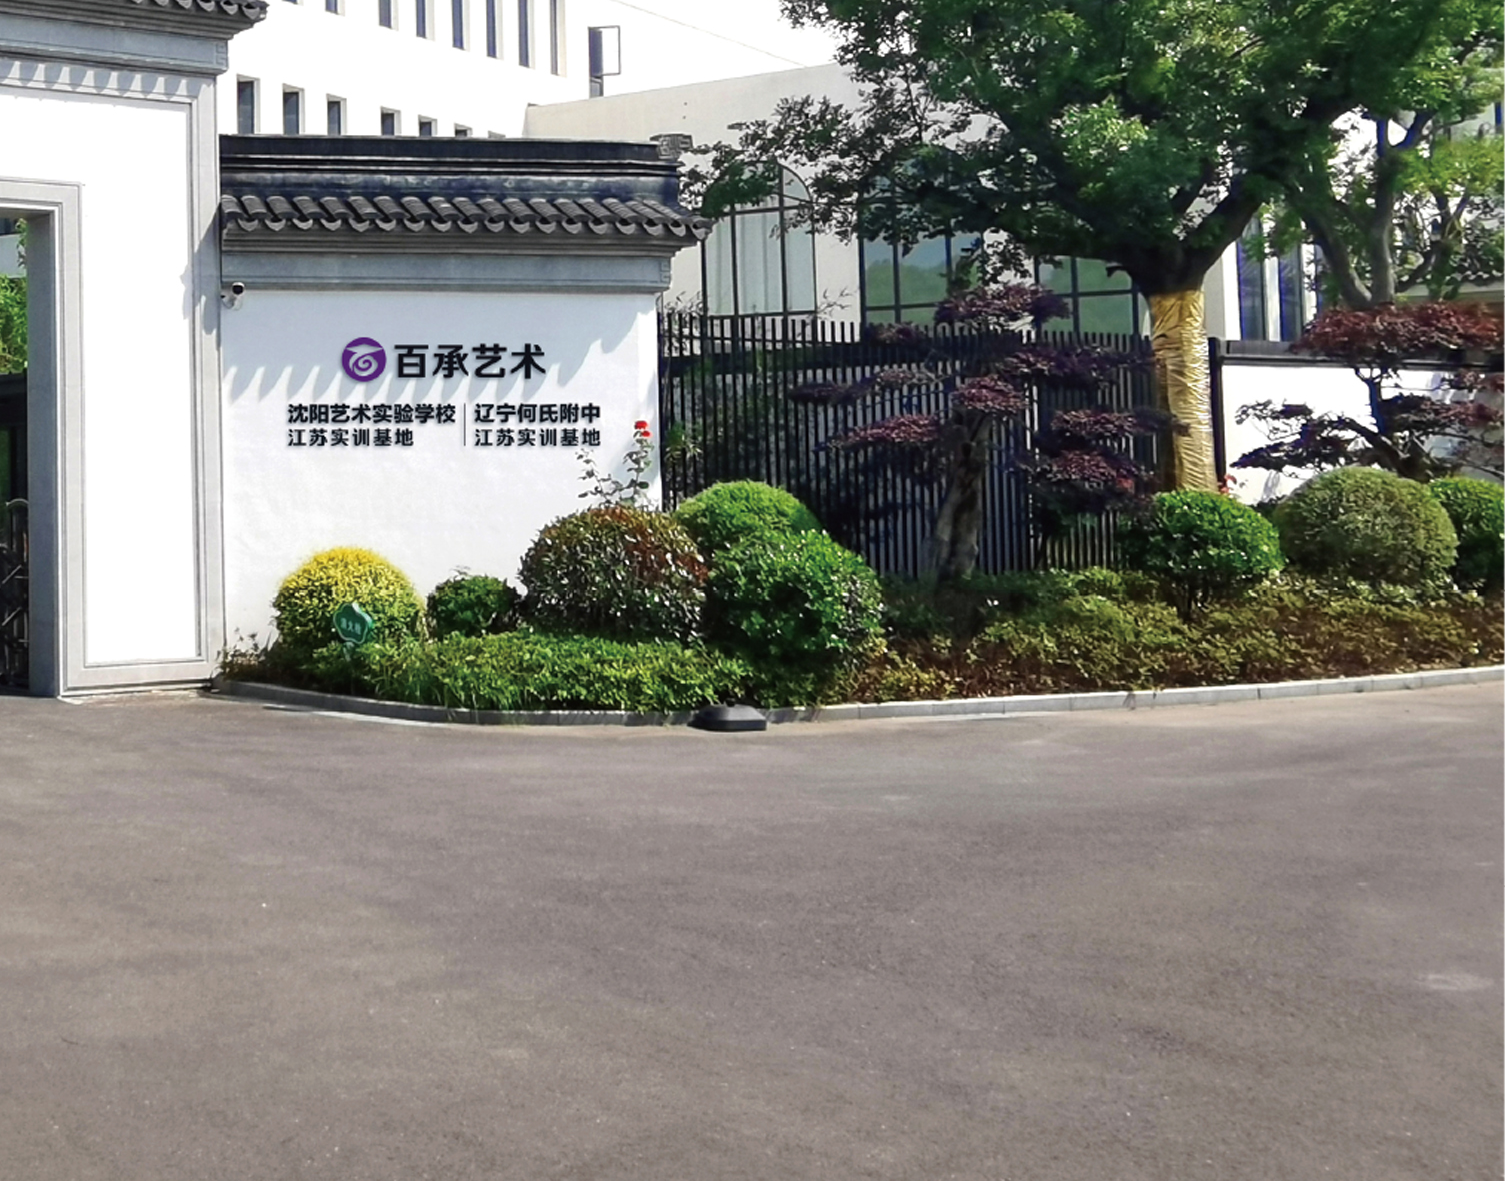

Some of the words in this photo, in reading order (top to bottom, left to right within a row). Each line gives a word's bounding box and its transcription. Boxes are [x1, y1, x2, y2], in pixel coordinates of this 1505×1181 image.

[394, 343, 546, 380] 百承艺术
[288, 403, 456, 424] 沈阳艺术实验学校
[474, 403, 601, 424] 辽宁何氏附中
[288, 428, 414, 447] 江苏实训基地
[474, 428, 601, 447] 江苏实训基地
